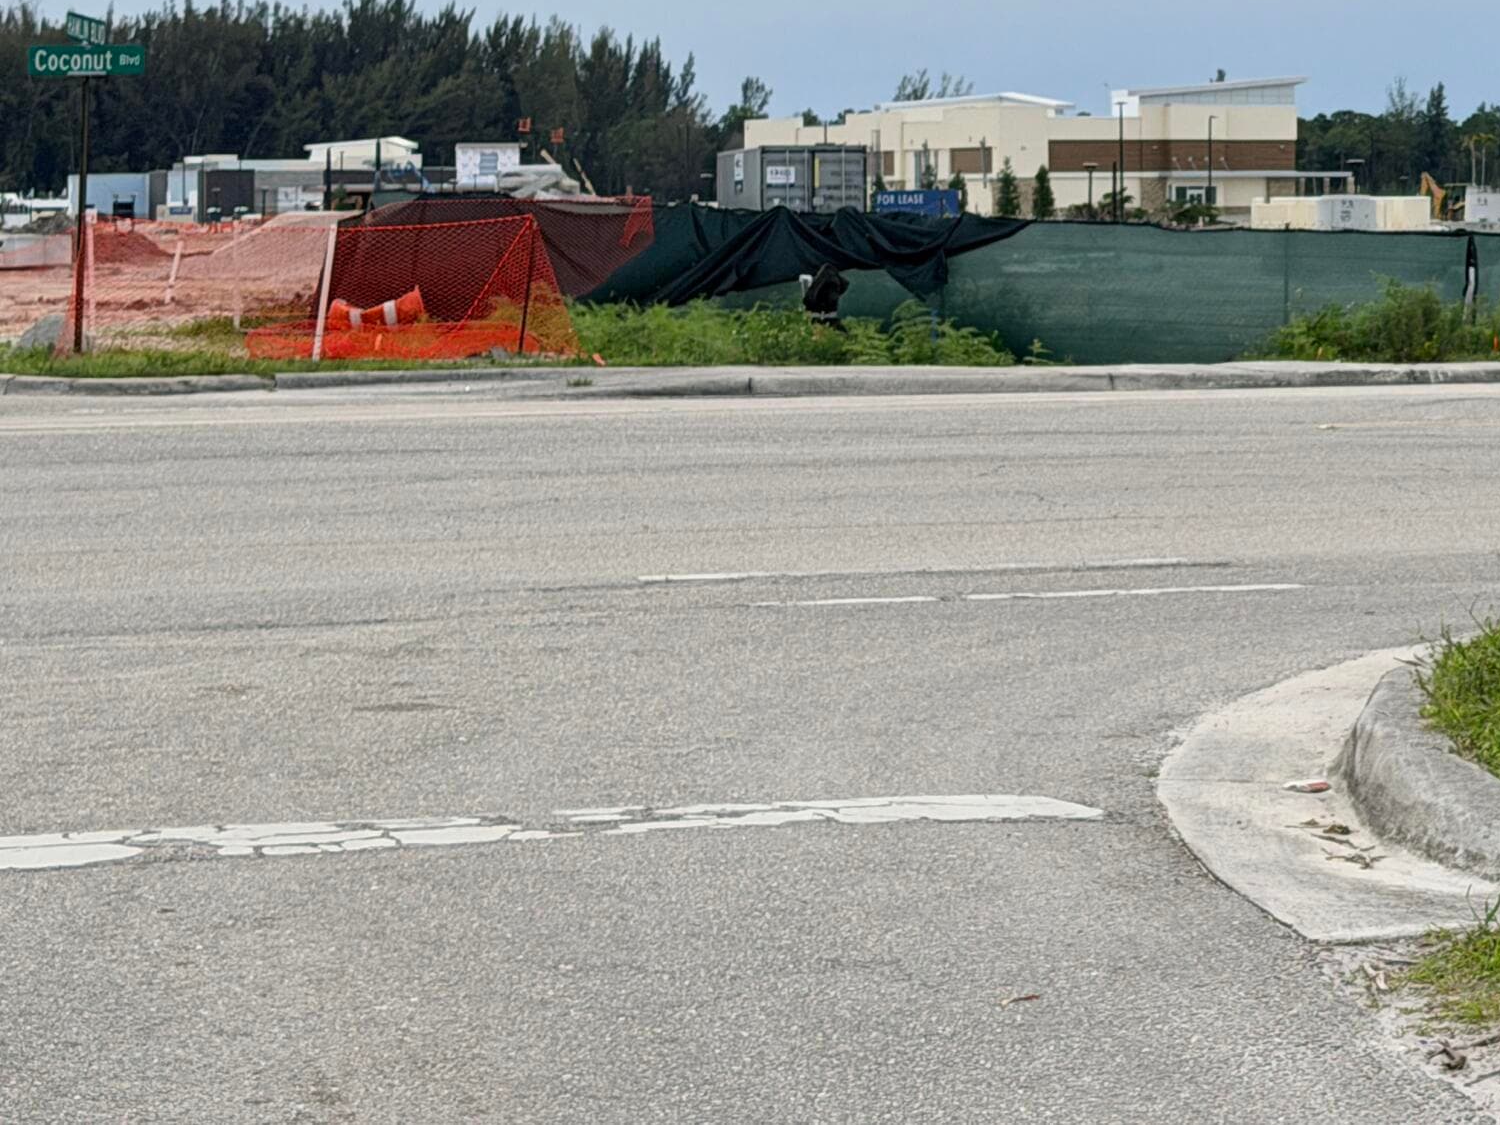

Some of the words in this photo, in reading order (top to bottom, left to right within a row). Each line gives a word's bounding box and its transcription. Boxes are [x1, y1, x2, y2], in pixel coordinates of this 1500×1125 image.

[34, 49, 113, 72] Coconut
[119, 53, 141, 67] Blvd
[876, 193, 895, 205] FOR
[897, 193, 925, 205] LEASE
